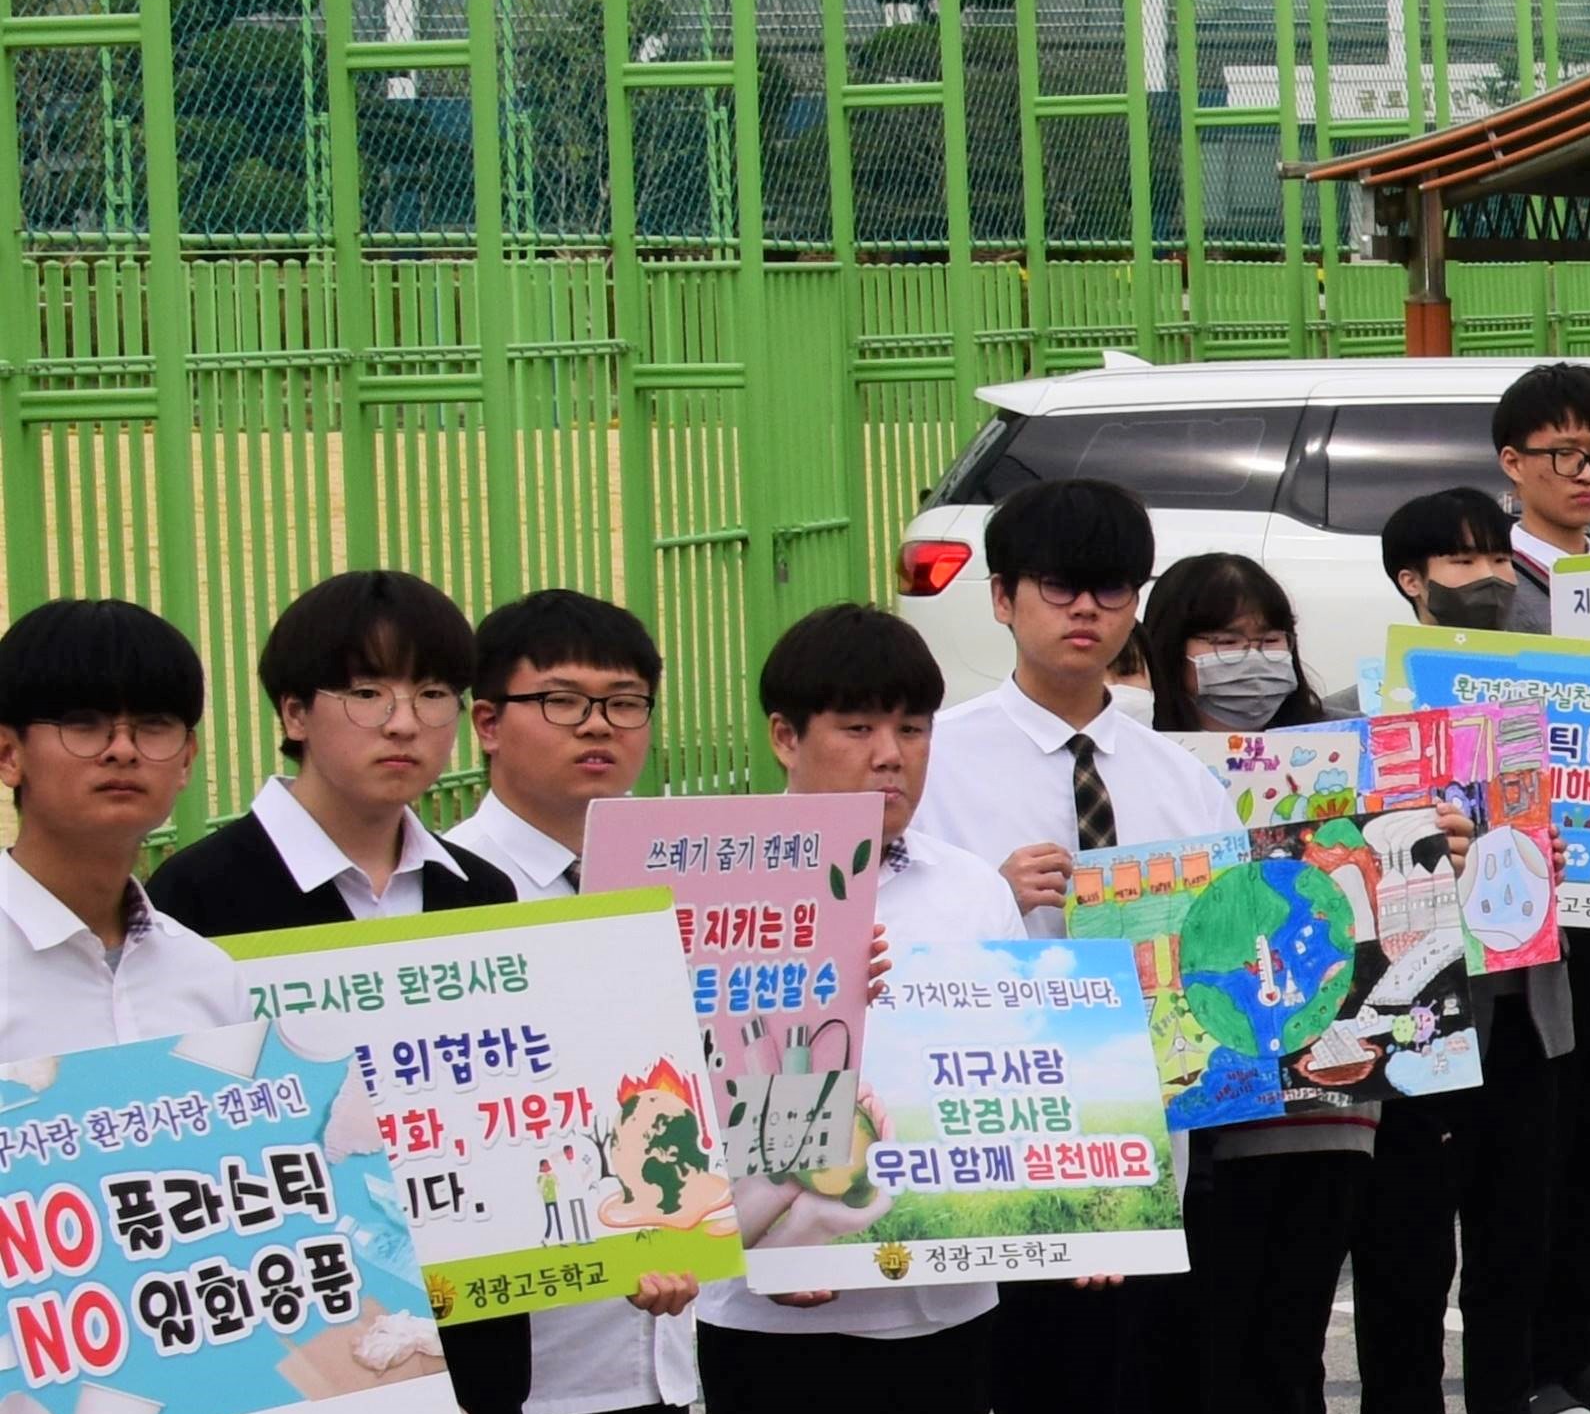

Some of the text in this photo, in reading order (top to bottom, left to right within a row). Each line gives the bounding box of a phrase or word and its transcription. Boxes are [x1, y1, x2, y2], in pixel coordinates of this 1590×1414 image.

[1369, 697, 1544, 789] 레기를
[645, 833, 820, 873] 쓰레기 줍기 캠페인
[703, 905, 784, 950] 지키는
[793, 901, 816, 948] 일
[251, 953, 530, 1020] 지구사랑 환경사랑
[727, 963, 807, 1013] 실천할
[812, 962, 839, 1005] 수
[902, 981, 992, 1009] 가치있는
[997, 979, 1044, 1008] 일이
[1047, 979, 1120, 1007] 됩니다.
[392, 1024, 553, 1086] 위협하는
[929, 1048, 1064, 1087] 지구사랑
[89, 1094, 209, 1148] 환경사랑
[218, 1077, 308, 1124] 캠페인
[477, 1086, 595, 1139] 기우가
[937, 1095, 1073, 1136] 환경사랑
[874, 1141, 1153, 1187] 우리 함께 실천해요
[0, 1152, 330, 1277] NO 플라스틱
[925, 1241, 1072, 1273] 정광고등학교
[466, 1260, 609, 1309] 정광고등학교
[16, 1243, 355, 1379] NO 일회용품
